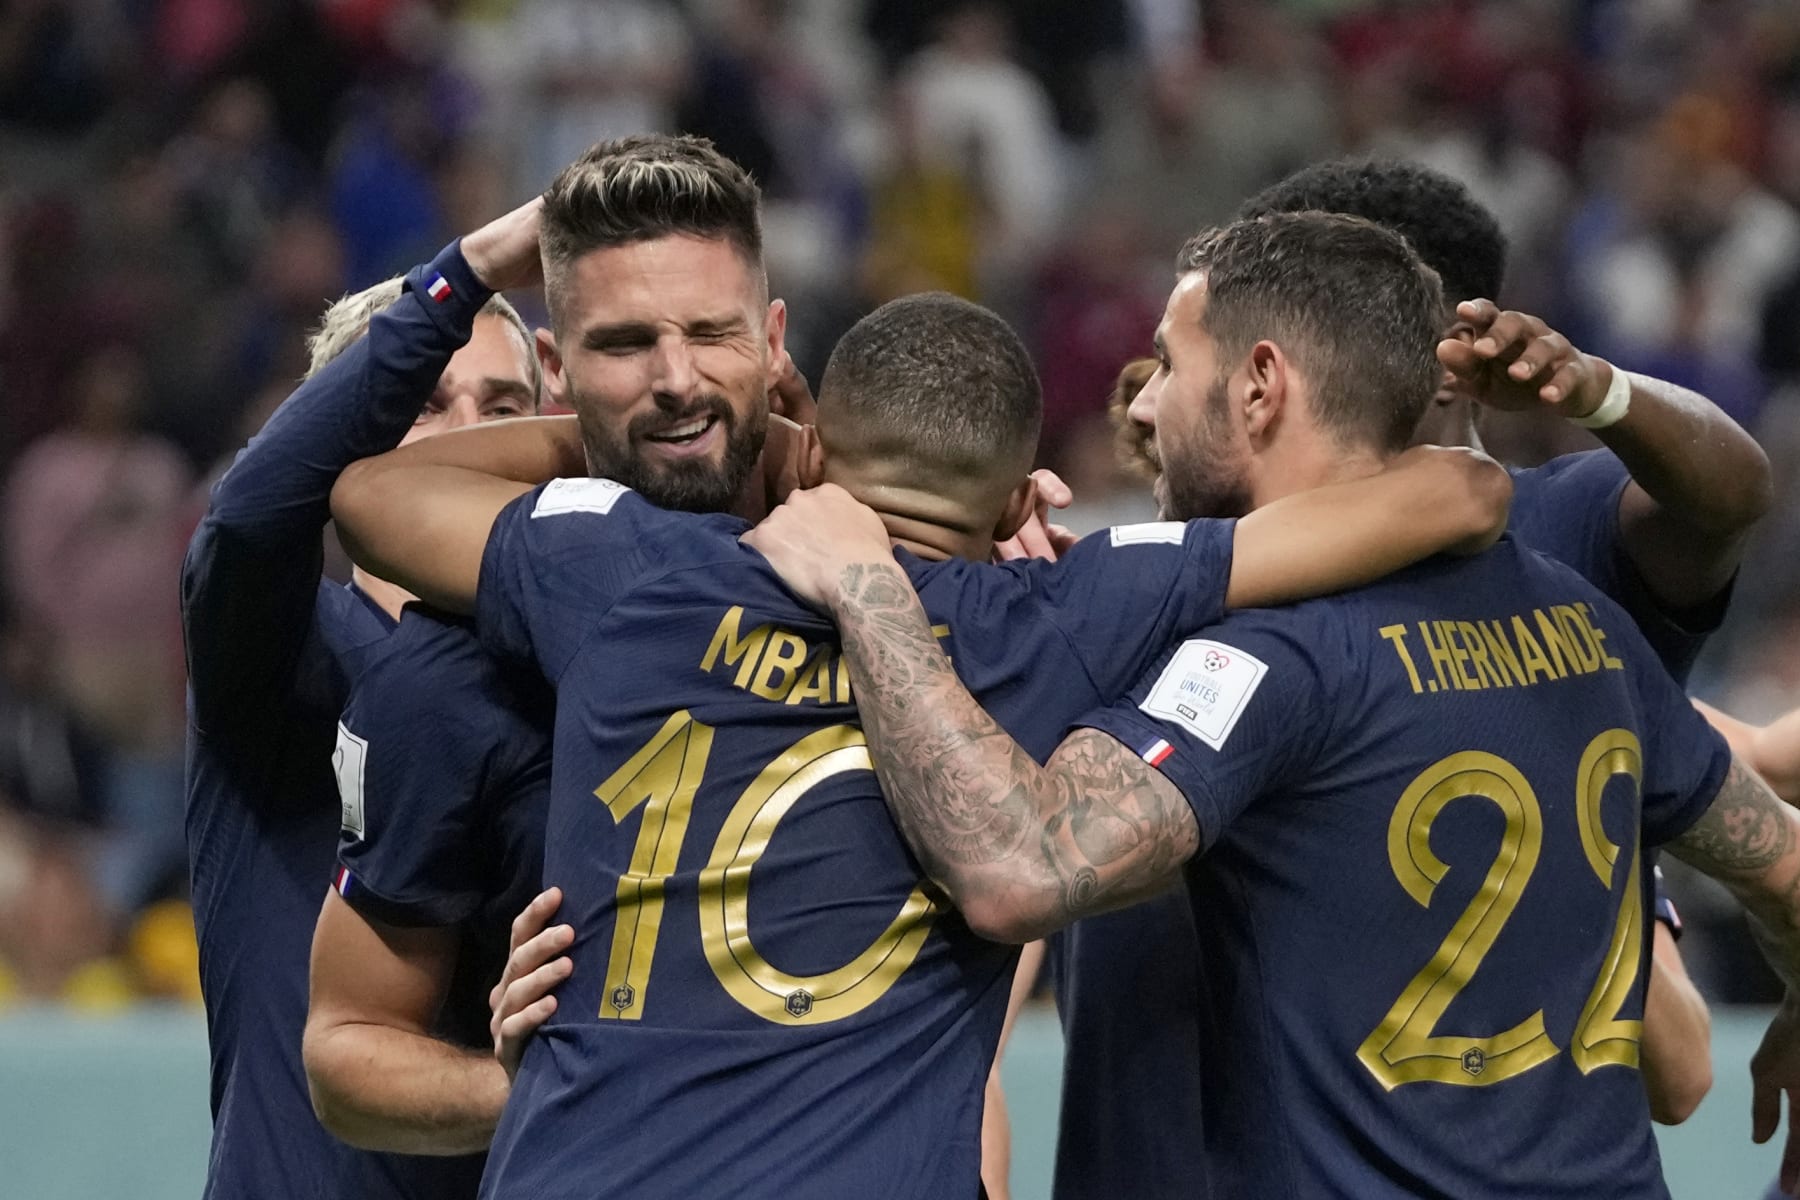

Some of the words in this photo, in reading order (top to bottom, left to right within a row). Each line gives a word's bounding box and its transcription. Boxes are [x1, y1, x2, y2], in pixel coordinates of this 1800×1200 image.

[1180, 679, 1219, 704] UNITES
[1378, 602, 1624, 694] T.HERNANDE
[593, 709, 936, 1026] 10
[1356, 728, 1643, 1092] 22
